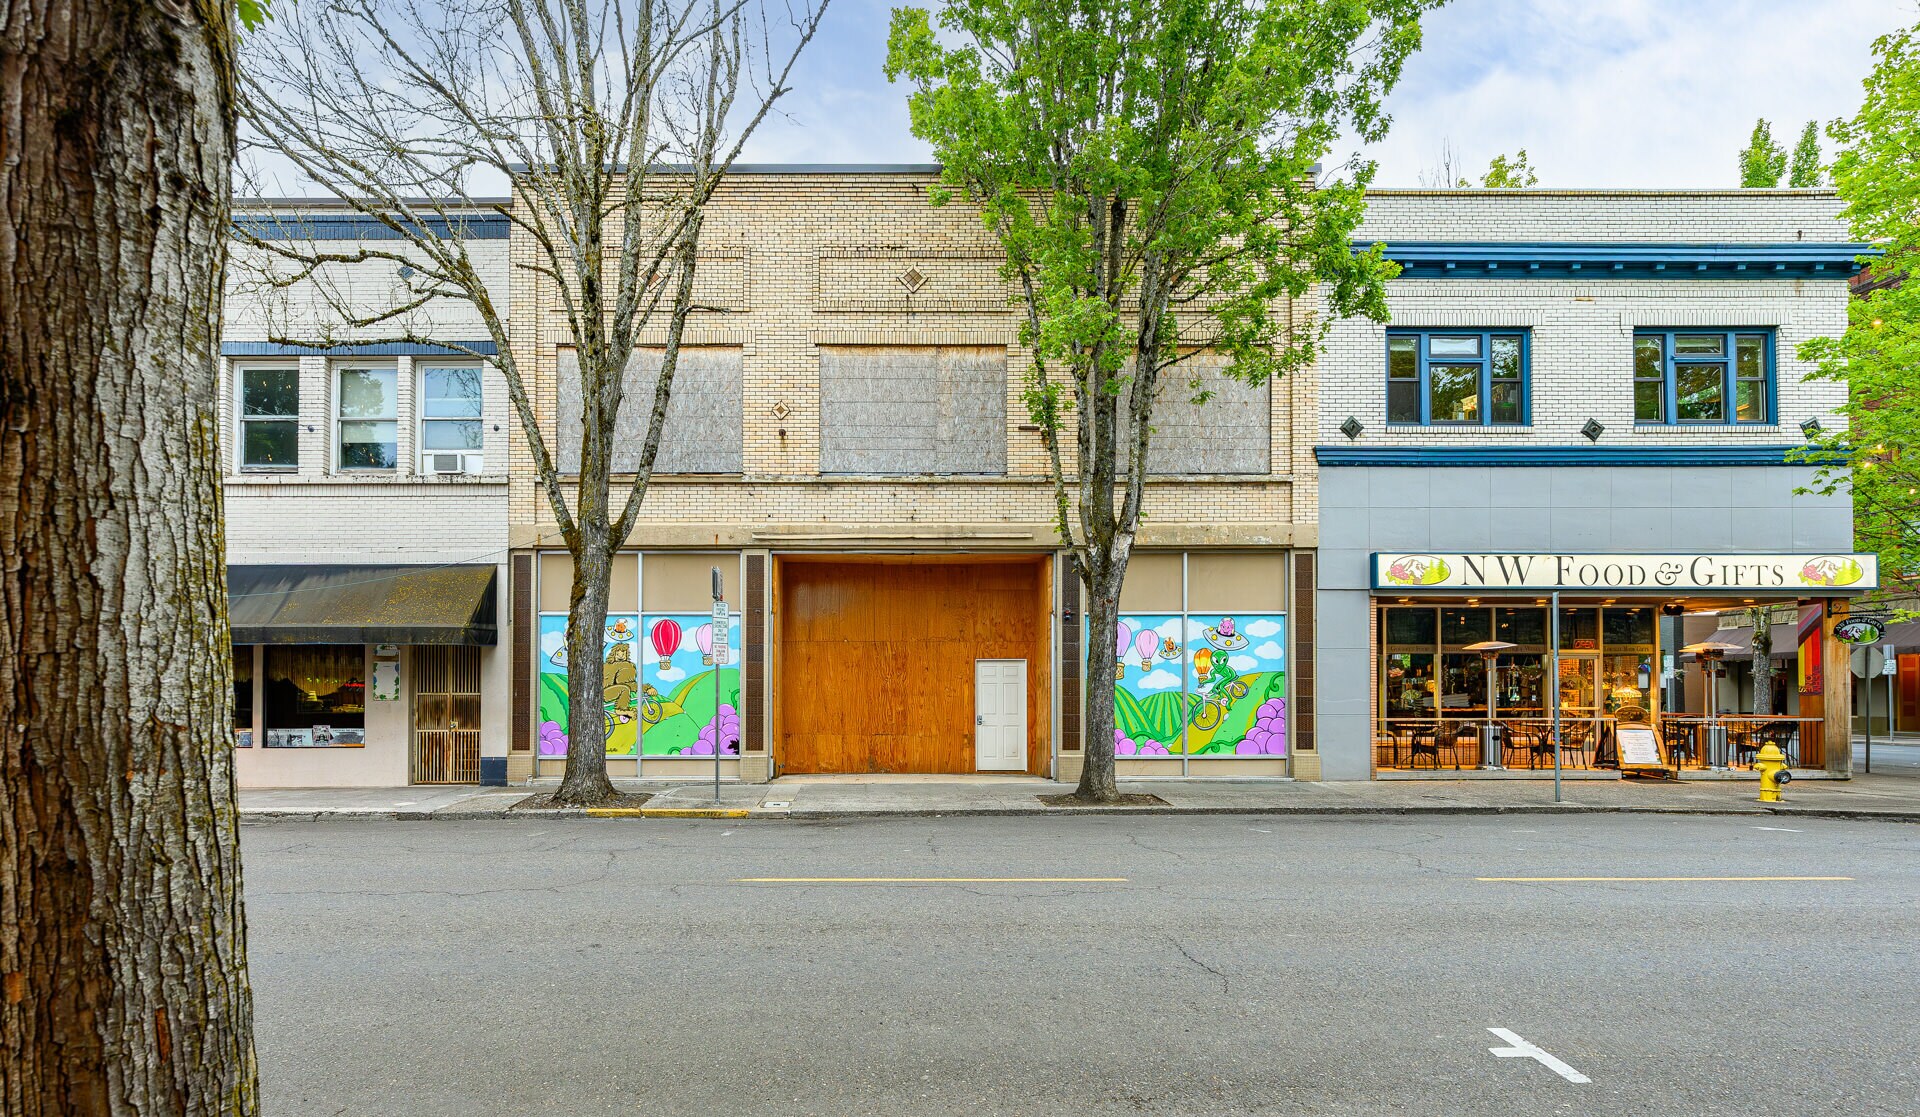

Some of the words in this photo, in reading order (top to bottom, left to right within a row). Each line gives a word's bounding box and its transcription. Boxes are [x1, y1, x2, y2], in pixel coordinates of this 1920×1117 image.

[1461, 555, 1536, 586] NW
[1553, 555, 1646, 587] FOOD
[1654, 562, 1684, 587] &
[1690, 555, 1784, 587] GIFTS
[1835, 622, 1845, 631] NW
[1575, 640, 1594, 649] OPEN
